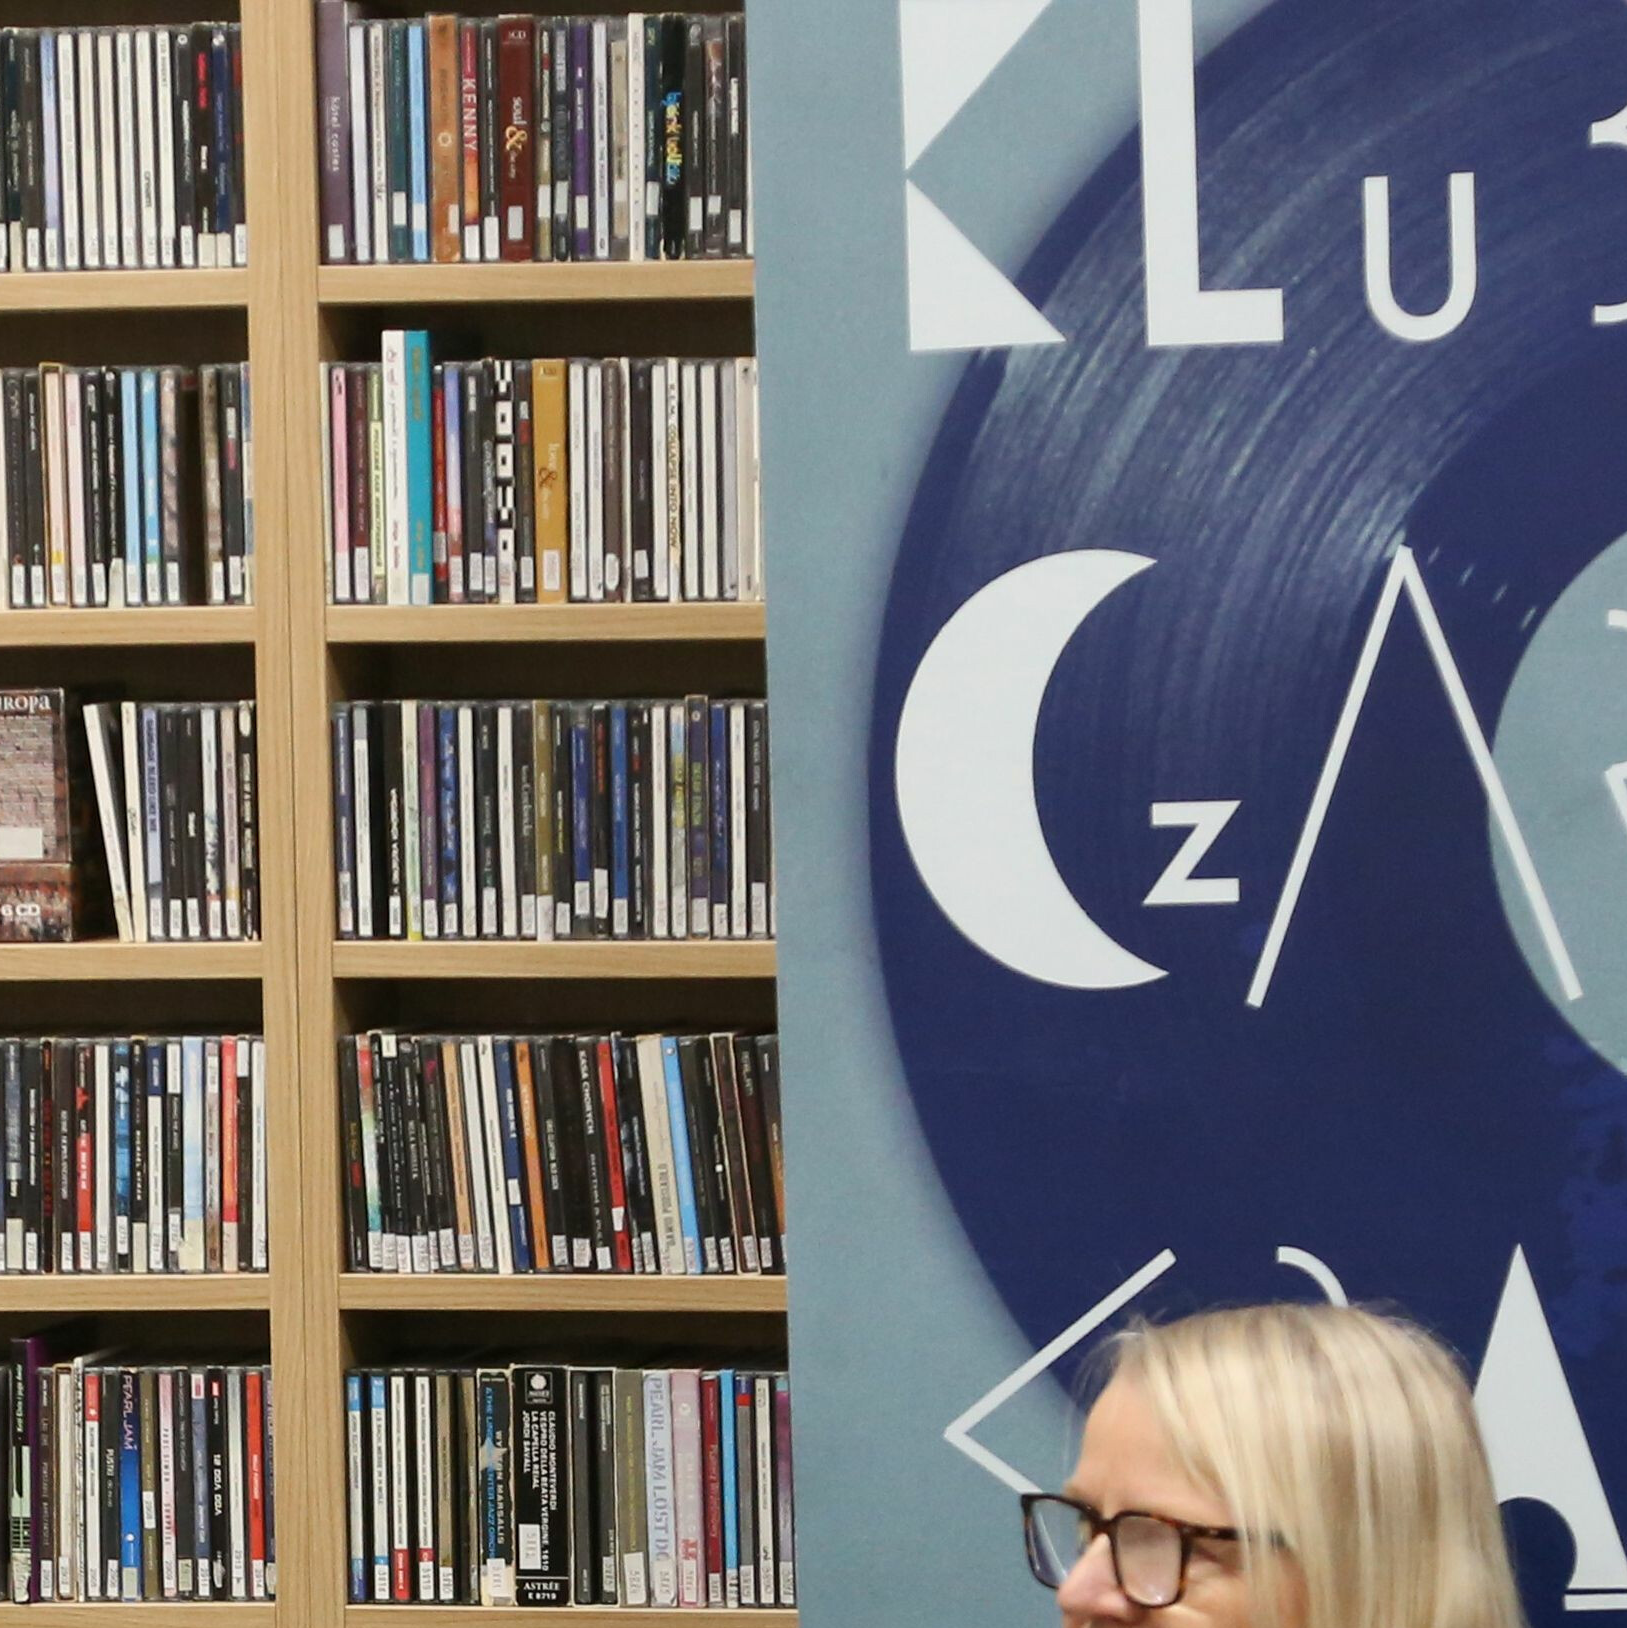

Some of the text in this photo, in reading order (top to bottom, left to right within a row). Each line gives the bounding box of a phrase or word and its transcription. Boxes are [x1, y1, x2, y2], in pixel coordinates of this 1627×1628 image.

[462, 77, 478, 151] KENNY
[505, 96, 528, 151] soul &
[670, 515, 678, 549] NOW
[0, 903, 41, 918] 6 CD
[122, 1375, 134, 1450] PEARL JAM
[539, 1410, 548, 1446] VESPRO
[522, 1411, 532, 1473] JORDI SAVALL
[531, 1410, 541, 1489] LA CAPELLA REIAL
[540, 1448, 548, 1475] DELLA
[548, 1411, 557, 1510] CLAUDIO MONTEVERDI
[650, 1376, 669, 1533] PEARL JAM LOST
[497, 1484, 505, 1544] MARSALIS
[540, 1477, 549, 1504] BEATA
[541, 1550, 550, 1571] 1610
